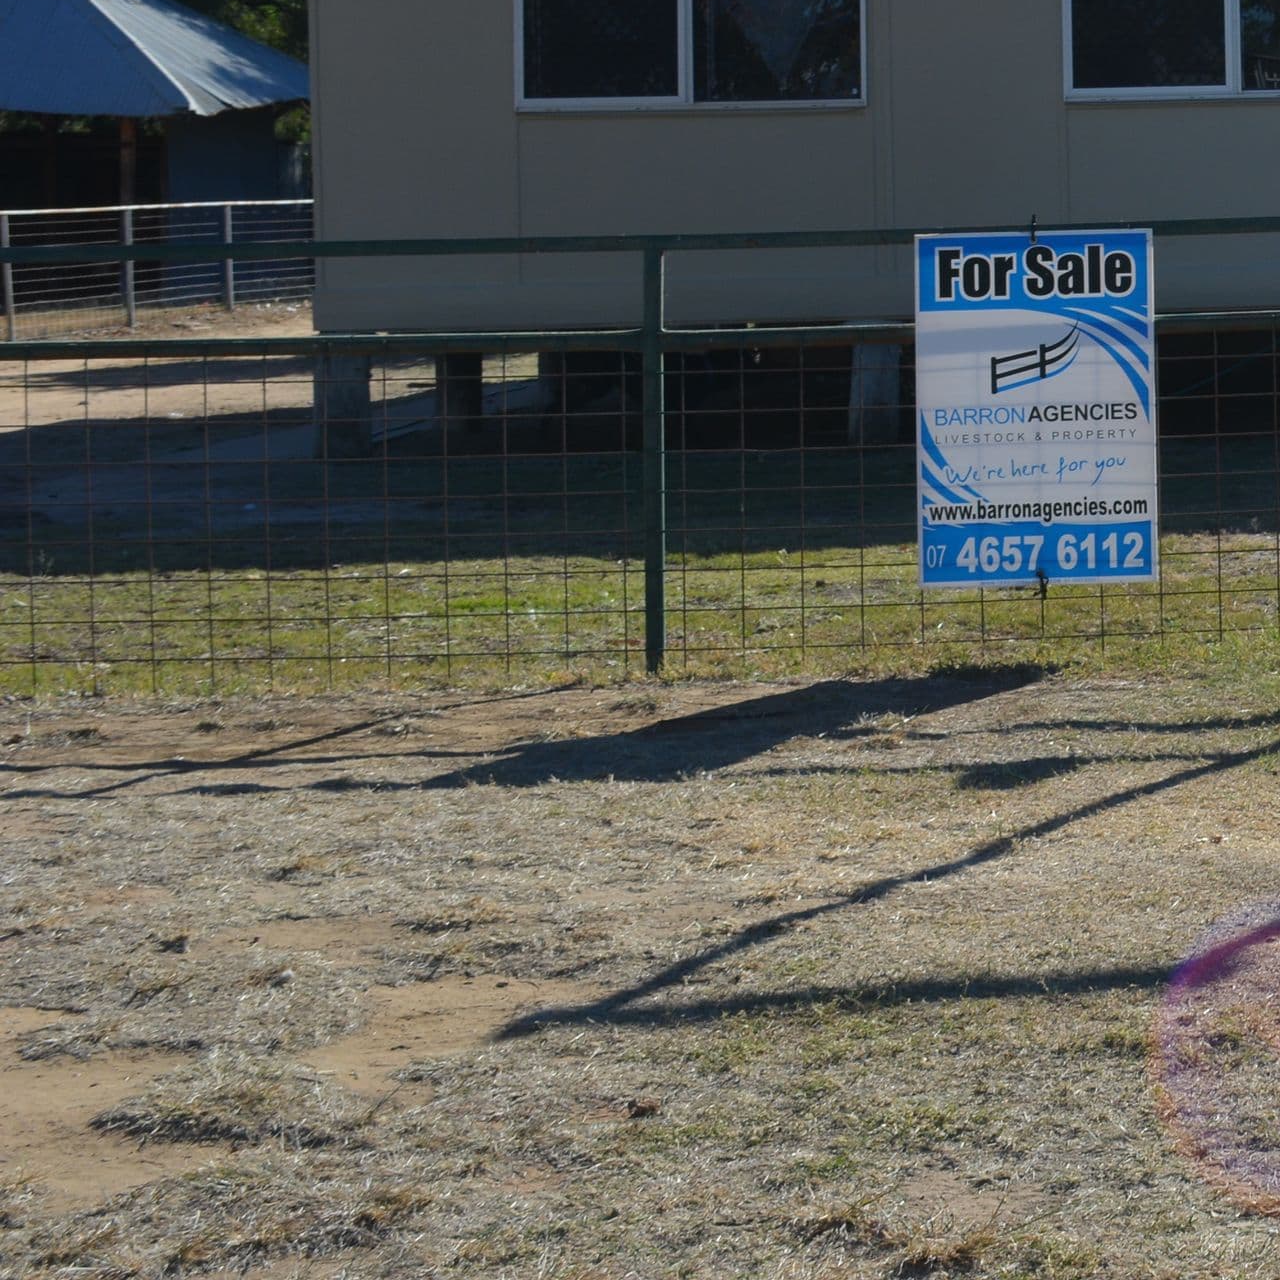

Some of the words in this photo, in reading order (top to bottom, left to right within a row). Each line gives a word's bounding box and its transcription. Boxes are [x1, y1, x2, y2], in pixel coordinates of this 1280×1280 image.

[937, 249, 1014, 299] For
[1025, 245, 1133, 297] Sale
[934, 432, 1026, 445] LIVESTOCK
[1034, 431, 1042, 441] &
[1051, 428, 1138, 441] PROPERTY
[945, 462, 1005, 484] We're
[1010, 459, 1048, 477] here
[1056, 457, 1087, 485] for
[1095, 454, 1127, 486] you
[929, 497, 1148, 523] www.barronagencies.com
[927, 545, 946, 568] 07
[956, 535, 1044, 573] 4657
[1056, 531, 1144, 570] 6112
